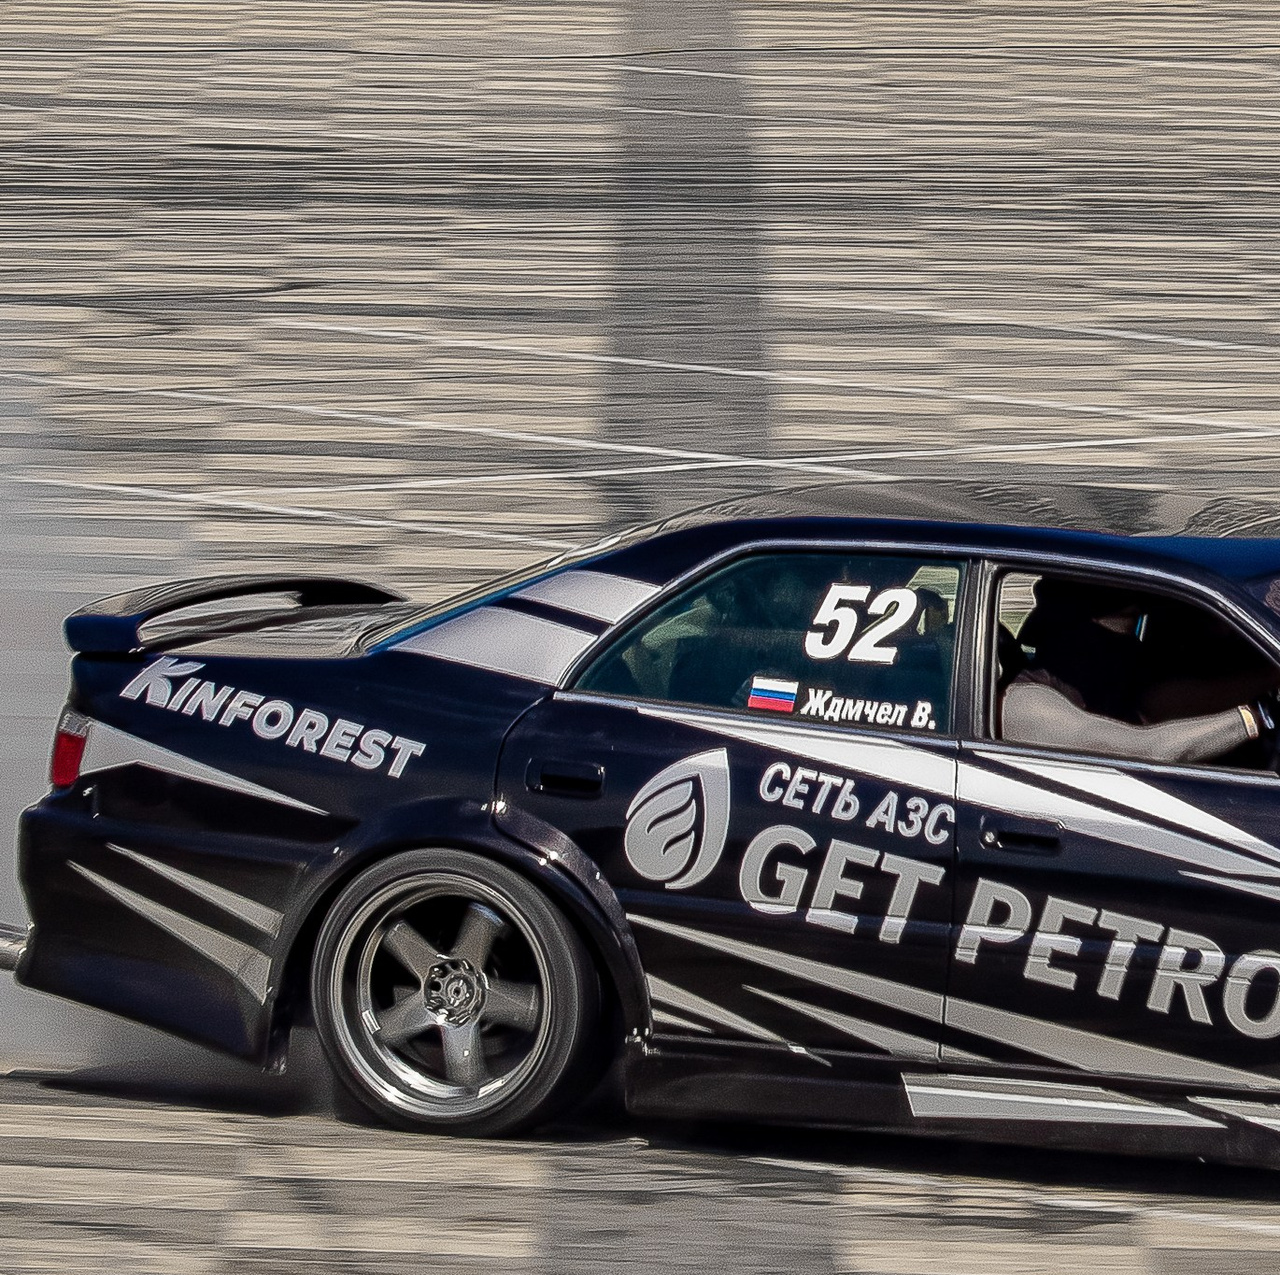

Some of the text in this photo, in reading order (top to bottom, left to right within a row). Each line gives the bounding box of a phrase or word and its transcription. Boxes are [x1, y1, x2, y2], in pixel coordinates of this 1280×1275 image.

[804, 582, 917, 665] 52
[119, 655, 426, 779] KINFOREST
[911, 700, 936, 729] В.
[759, 761, 956, 845] СЕТЬ АЗС
[739, 824, 946, 944] GET
